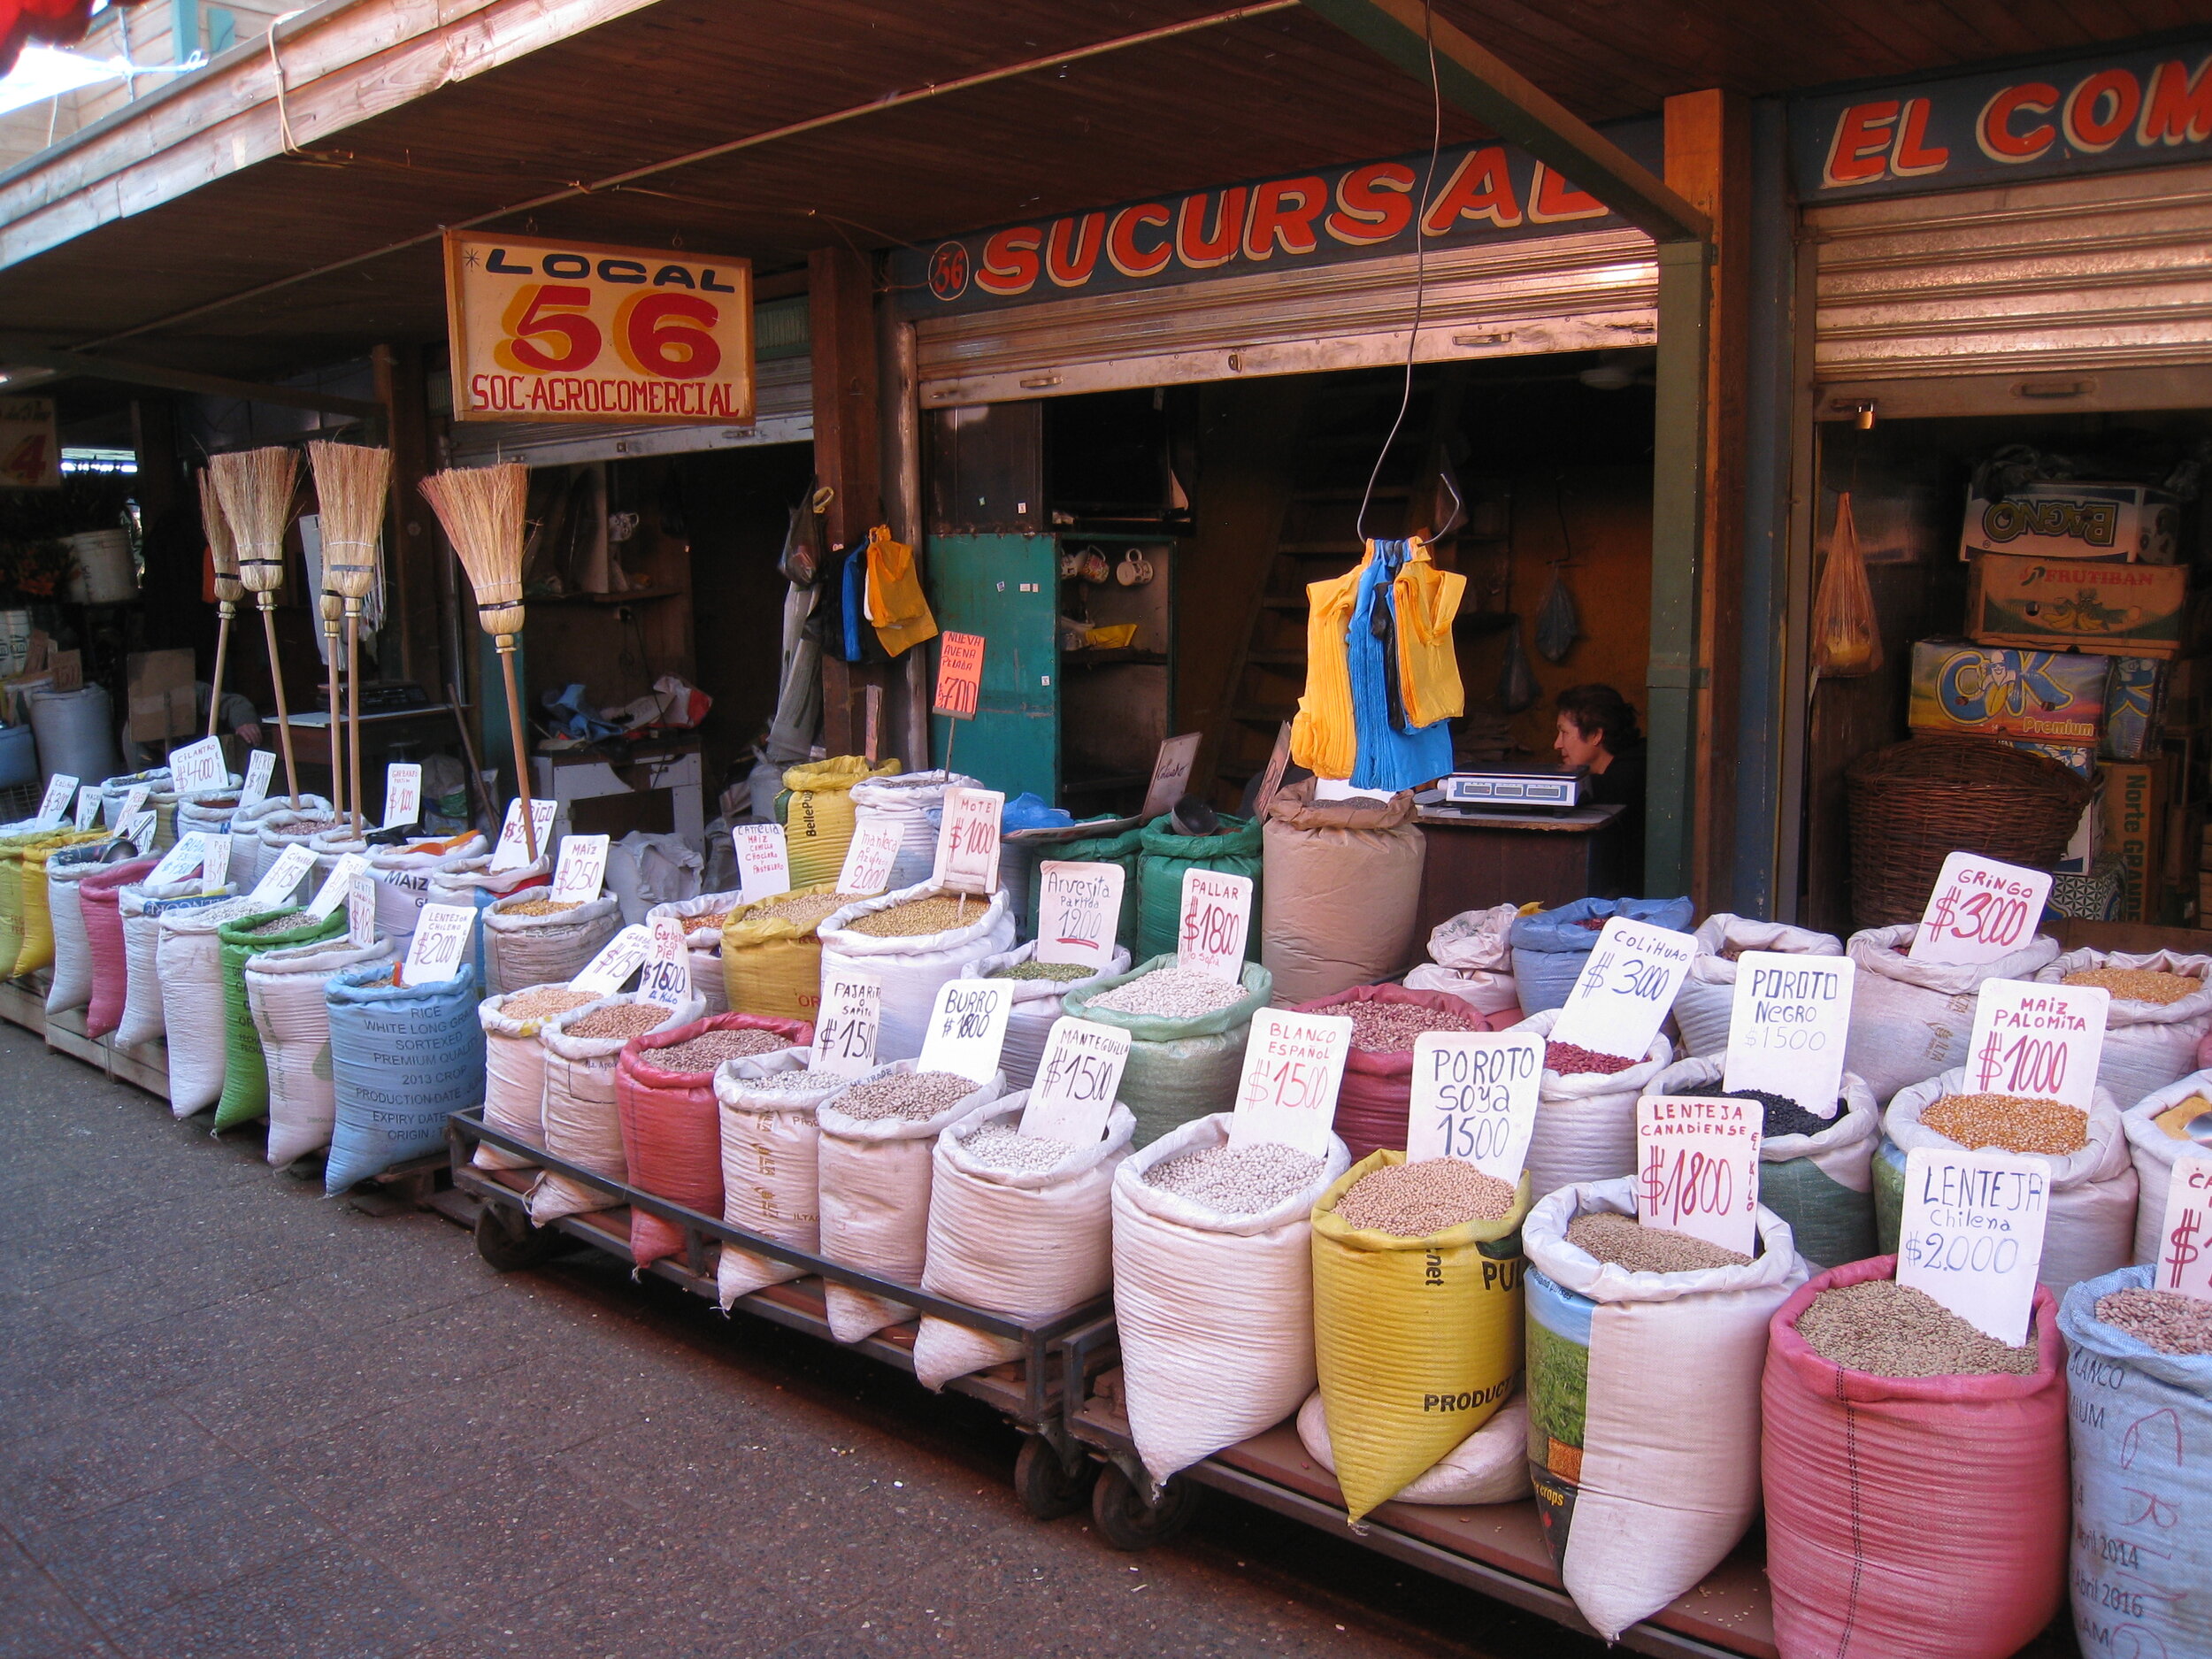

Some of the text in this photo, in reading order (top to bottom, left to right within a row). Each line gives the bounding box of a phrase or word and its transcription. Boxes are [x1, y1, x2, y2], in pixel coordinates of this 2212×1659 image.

[1822, 98, 1950, 189] EL
[934, 146, 1610, 296] 56 SUCURSAL
[486, 249, 735, 293] LOCAL
[494, 284, 722, 380] 56
[10, 434, 46, 483] 4
[1982, 500, 2119, 548] BAGNO
[2045, 568, 2154, 586] FRUTIBAN
[944, 645, 976, 659] AVENA
[948, 632, 981, 647] NUEVA
[2023, 716, 2094, 736] Premium
[2124, 775, 2147, 833] Norte
[383, 871, 428, 891] MAIZ
[556, 857, 599, 895] $250
[1192, 879, 1239, 900] PALLAR
[1058, 908, 1102, 940] 1200
[1183, 895, 1240, 952] $1800
[1924, 885, 2028, 947] $3000
[1581, 951, 1671, 1002] $3000
[1752, 969, 1838, 1001] POROTO
[411, 1006, 442, 1018] RICE
[944, 988, 998, 1014] BURRO
[364, 1019, 405, 1034] WHITE
[410, 1022, 447, 1034] LONG
[396, 1031, 463, 1051] SORTEXED
[1270, 1022, 1337, 1044] BLANCO
[1744, 1027, 1826, 1051] $1500
[373, 1052, 437, 1066] PREMIUM
[403, 1065, 467, 1085] 2013 CROP
[1041, 1046, 1113, 1102] $1500
[1431, 1047, 1535, 1085] POROTO
[1977, 1031, 2068, 1094] $1000
[1244, 1057, 1328, 1112] $1500
[373, 1110, 415, 1124] EXPIRY
[1654, 1103, 1742, 1120] LENTEJA
[388, 1129, 428, 1141] ORIGIN
[1435, 1113, 1509, 1160] 1500
[1640, 1145, 1732, 1226] $1800
[1923, 1165, 2043, 1212] LENTEJA
[1930, 1209, 2011, 1232] Chilena
[1905, 1231, 2019, 1274] $2.000
[1540, 1486, 1564, 1507] crops
[2100, 1535, 2139, 1570] 2014
